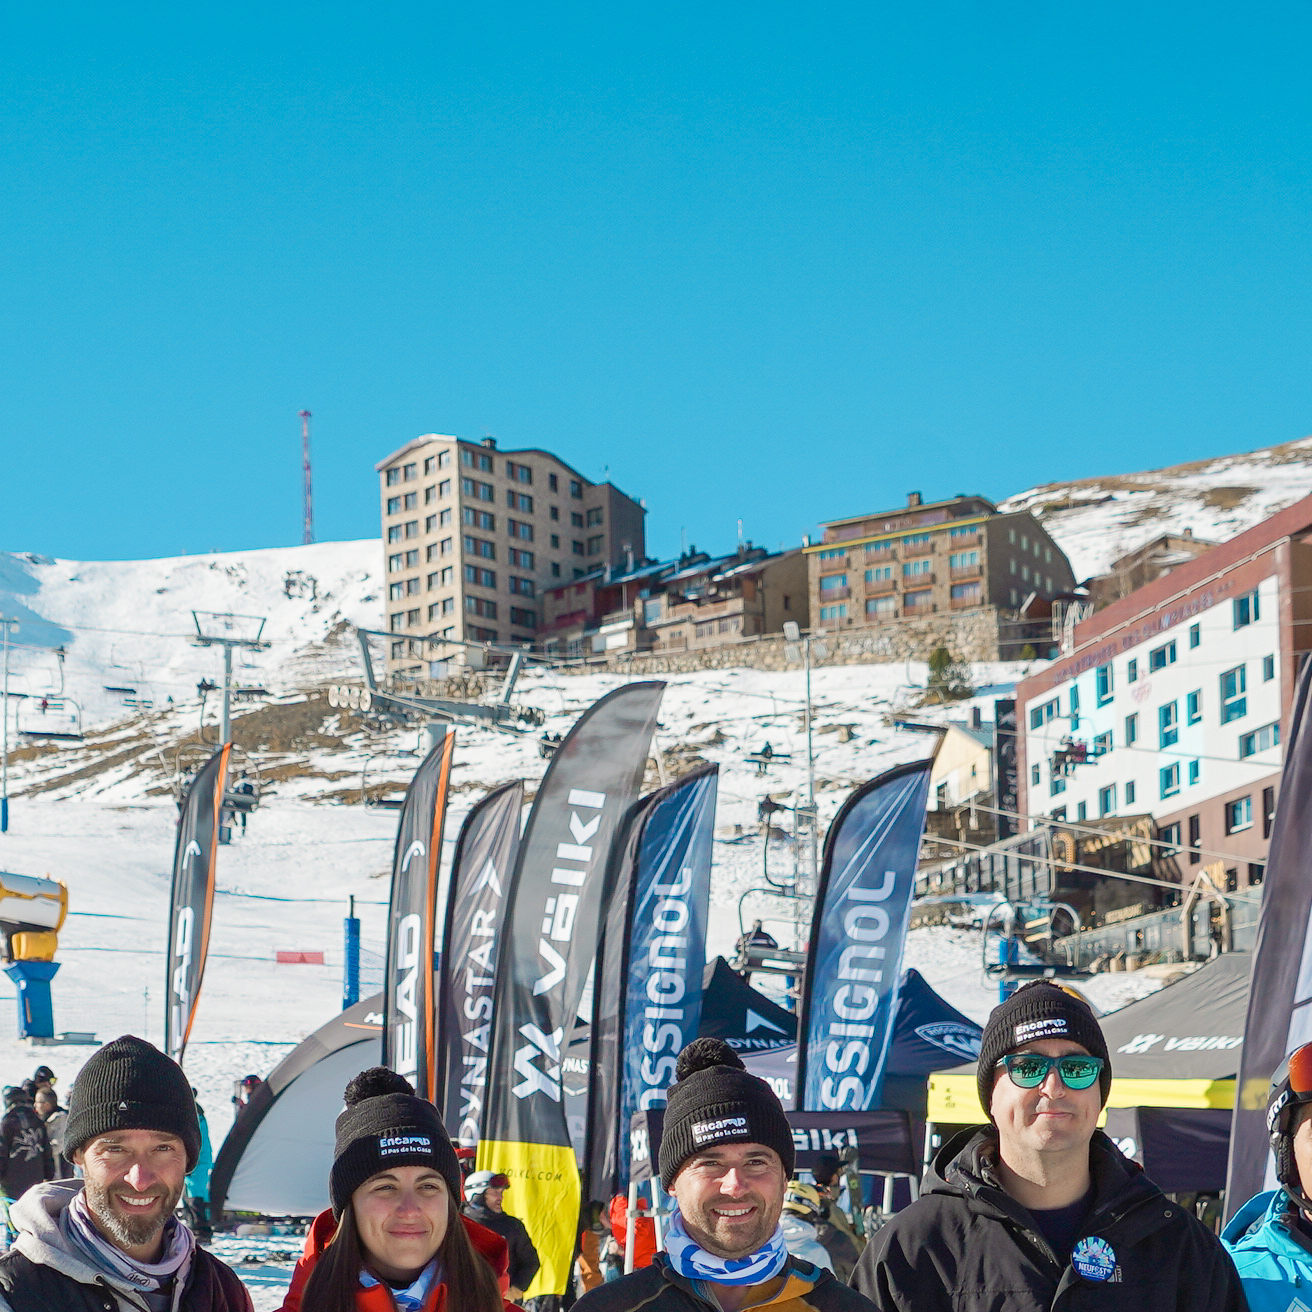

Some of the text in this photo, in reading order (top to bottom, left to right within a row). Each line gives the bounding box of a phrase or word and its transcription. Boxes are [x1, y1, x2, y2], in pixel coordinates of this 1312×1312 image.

[394, 912, 421, 1076] EAD
[457, 908, 495, 1147] DYNASTAR
[1015, 1018, 1067, 1036] Encamp
[694, 1116, 747, 1135] Encamp
[379, 1136, 431, 1148] Encamp
[703, 1133, 715, 1141] Pas
[714, 1130, 724, 1138] de
